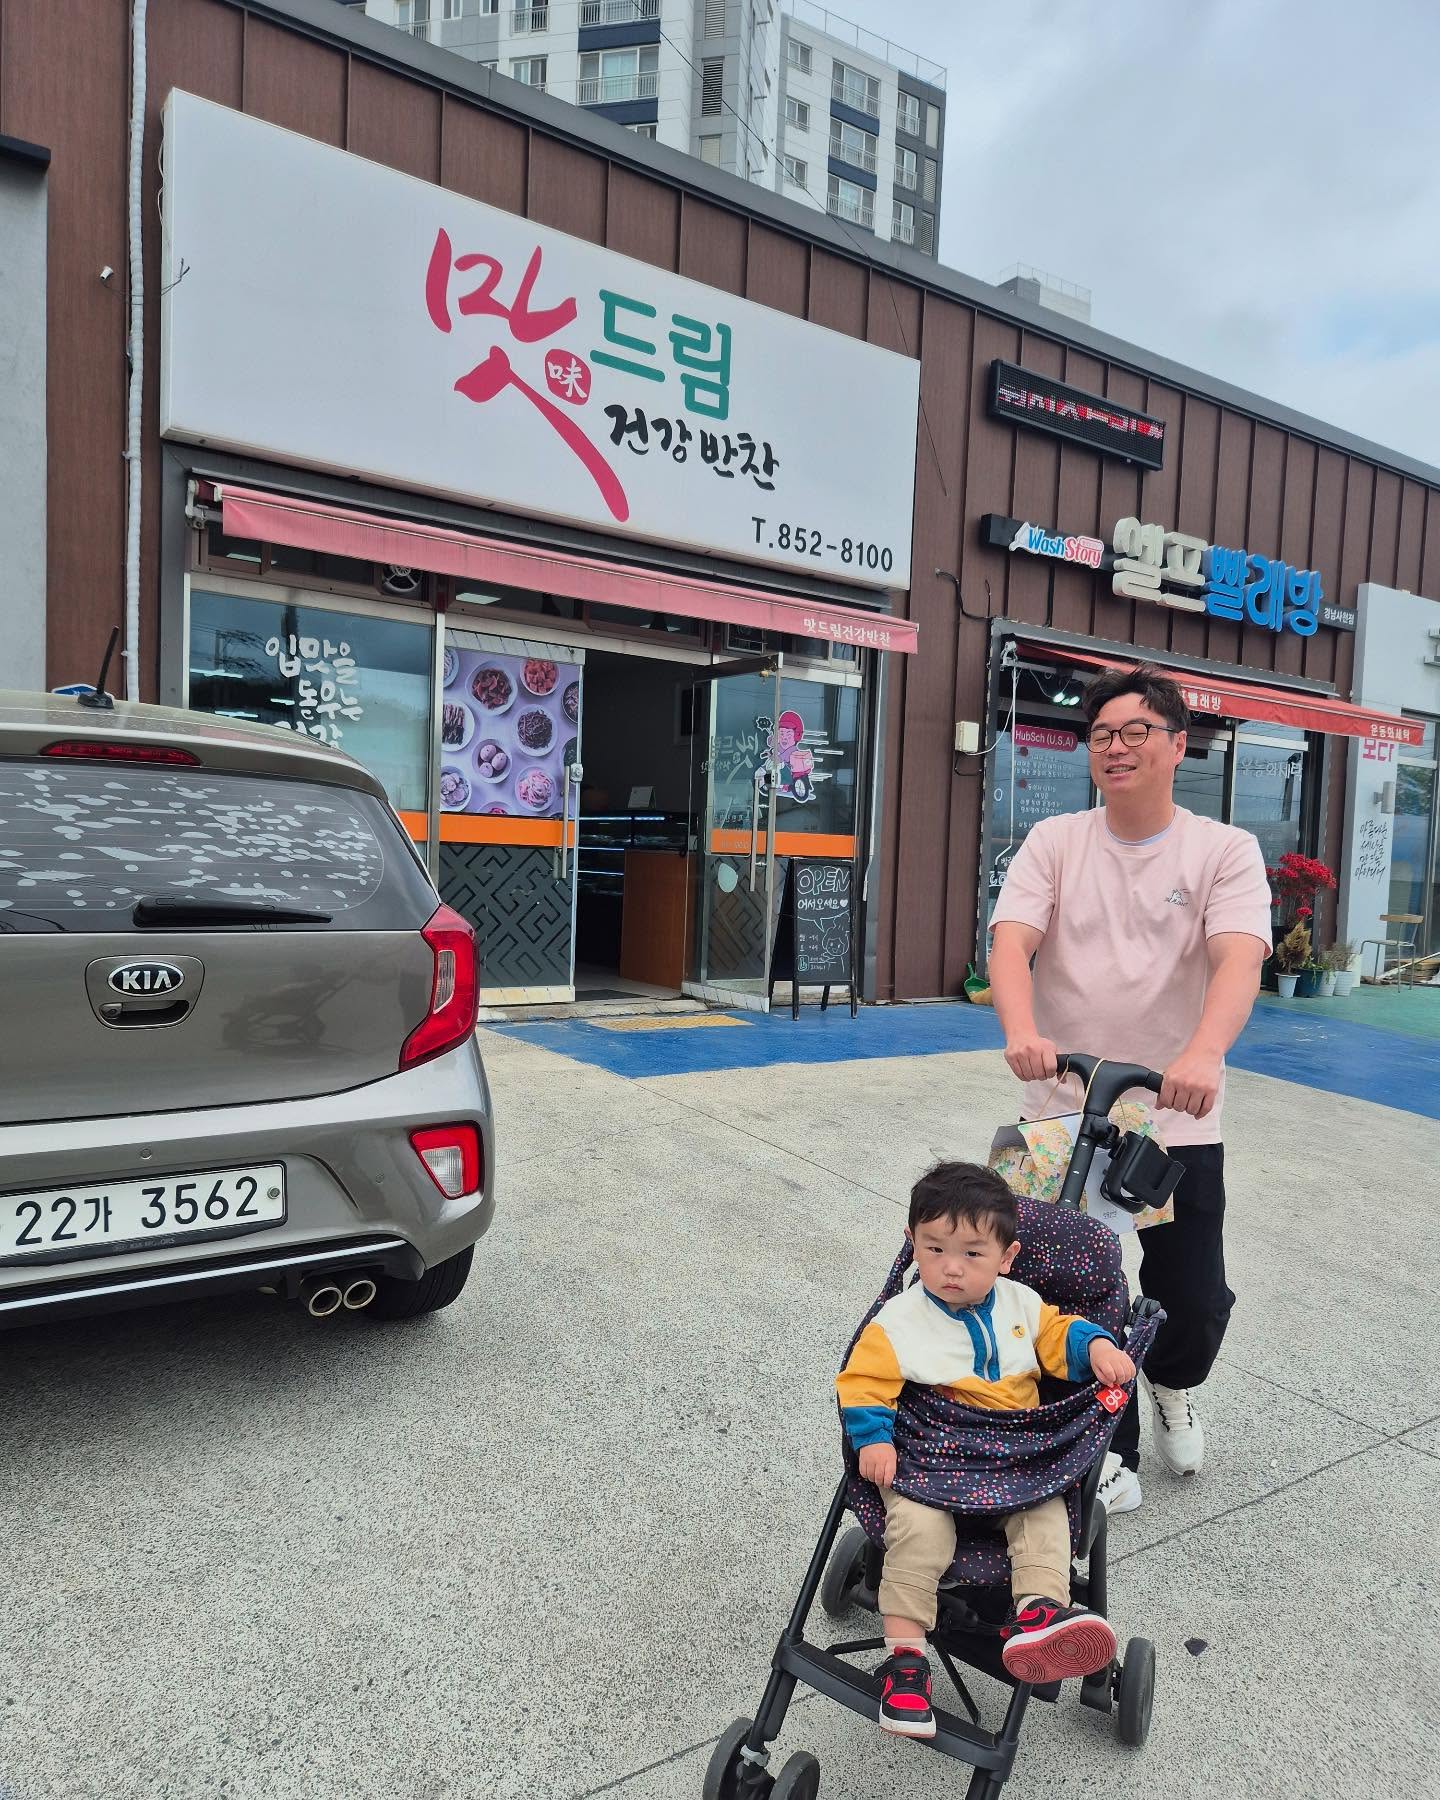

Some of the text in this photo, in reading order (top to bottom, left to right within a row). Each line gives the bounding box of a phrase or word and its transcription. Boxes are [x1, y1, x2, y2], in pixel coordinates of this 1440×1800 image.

[752, 516, 893, 572] T.852-8100
[803, 618, 891, 647] 맛드림건강반찬
[265, 634, 360, 685] 입맛을
[1015, 730, 1046, 744] HubSch
[796, 865, 851, 896] OPEN
[797, 898, 840, 911] 어서오세요
[121, 969, 173, 990] KIA
[14, 1175, 259, 1246] 22가 3562
